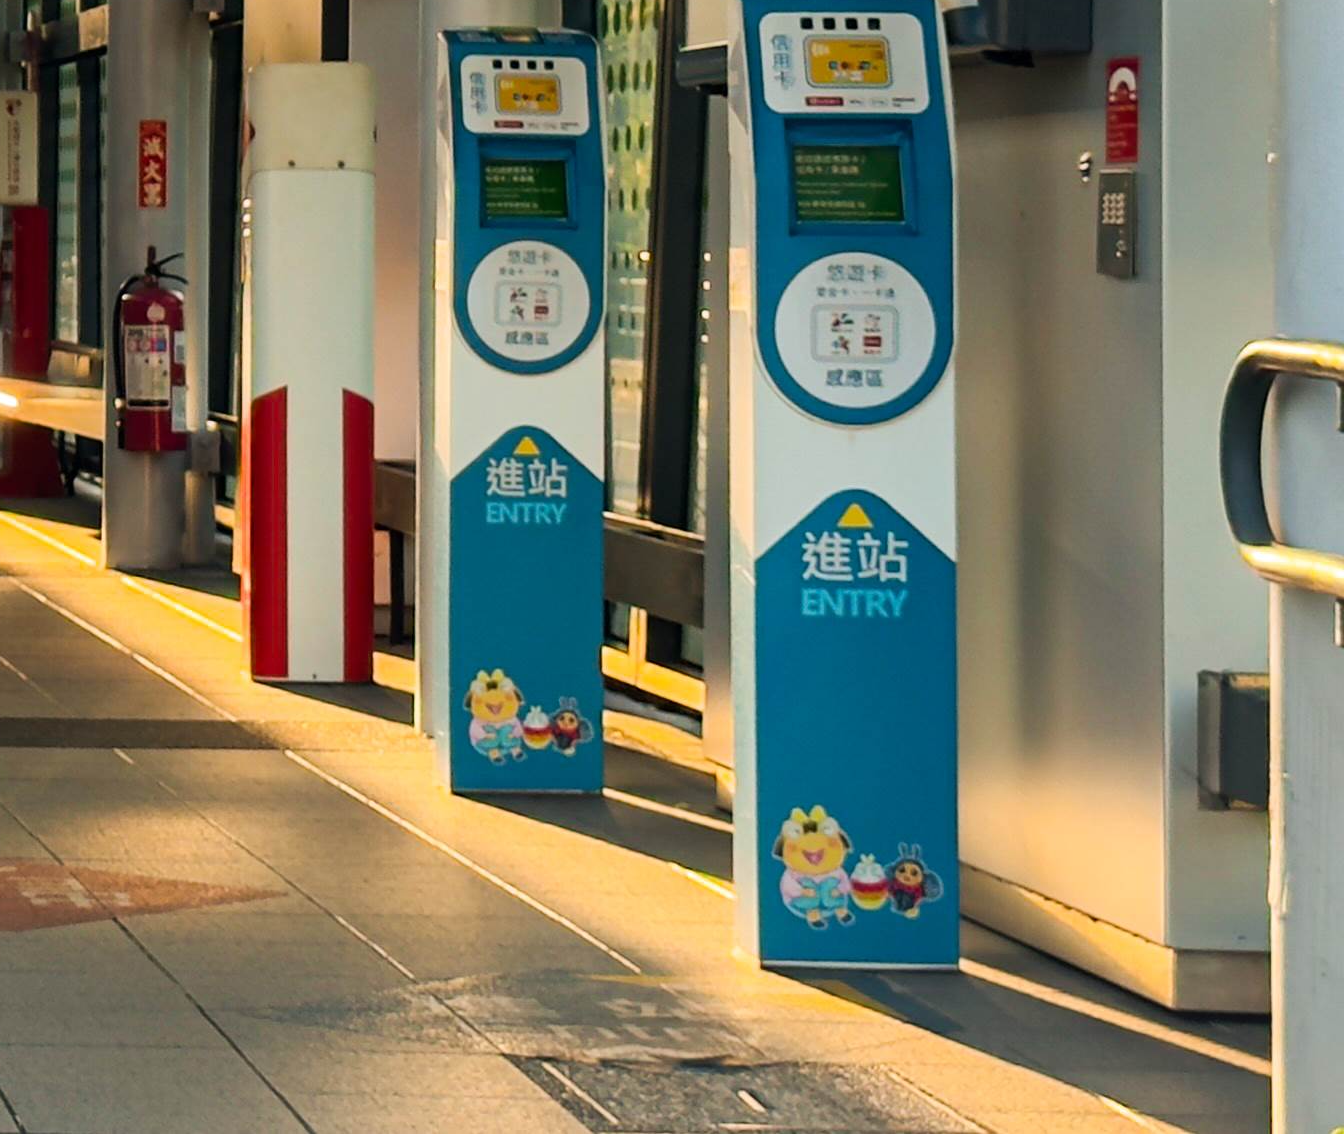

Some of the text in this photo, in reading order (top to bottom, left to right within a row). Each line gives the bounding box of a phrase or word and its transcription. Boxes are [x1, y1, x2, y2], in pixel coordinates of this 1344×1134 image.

[486, 457, 568, 498] 進站
[486, 502, 568, 525] ENTRY
[801, 531, 909, 583] 進站
[801, 588, 909, 617] ENTRY
